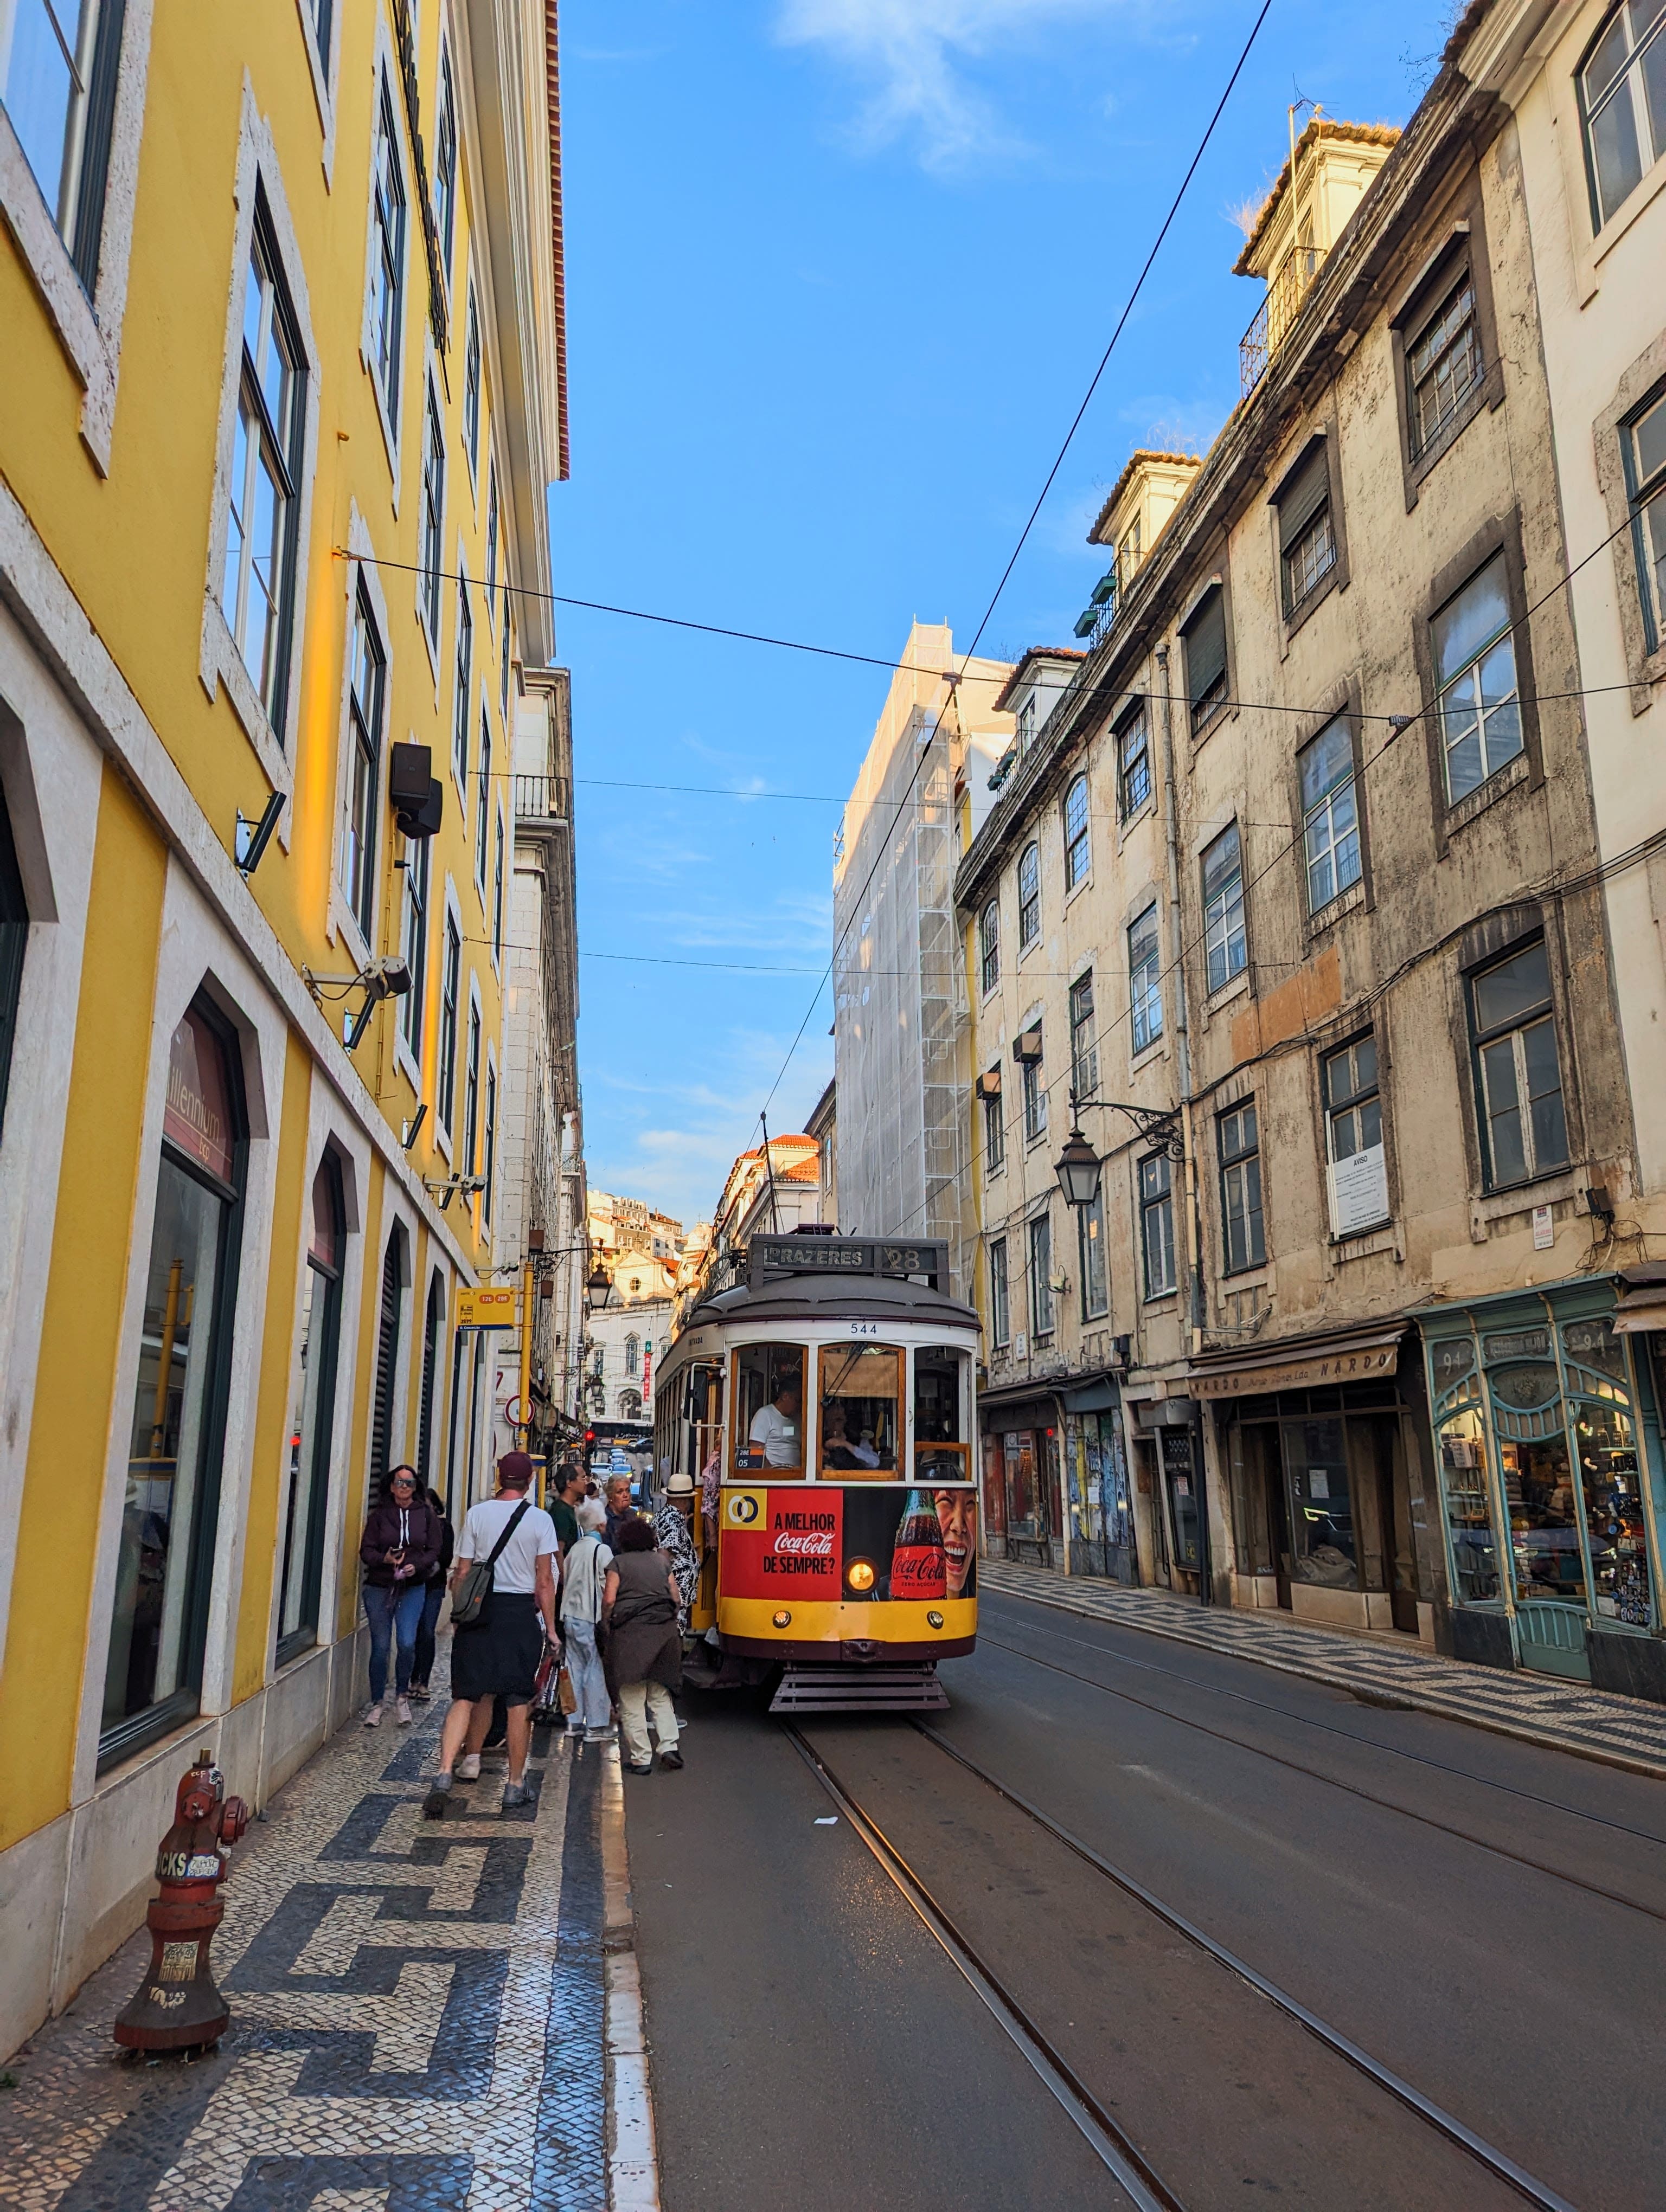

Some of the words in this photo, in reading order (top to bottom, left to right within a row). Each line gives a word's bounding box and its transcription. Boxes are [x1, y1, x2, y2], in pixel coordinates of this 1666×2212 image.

[199, 1137, 209, 1162] bcp
[1354, 1155, 1368, 1166] AVISO
[770, 1248, 863, 1266] PRAZERES
[889, 1249, 920, 1270] 28
[850, 1323, 877, 1334] 544
[1321, 1353, 1387, 1376] NARDO
[738, 1459, 748, 1467] 05
[774, 1513, 783, 1530] A
[785, 1513, 835, 1531] MELHOR
[774, 1532, 836, 1554] Coca-Cola
[764, 1556, 778, 1573] DE
[780, 1557, 835, 1574] SEMPRE?
